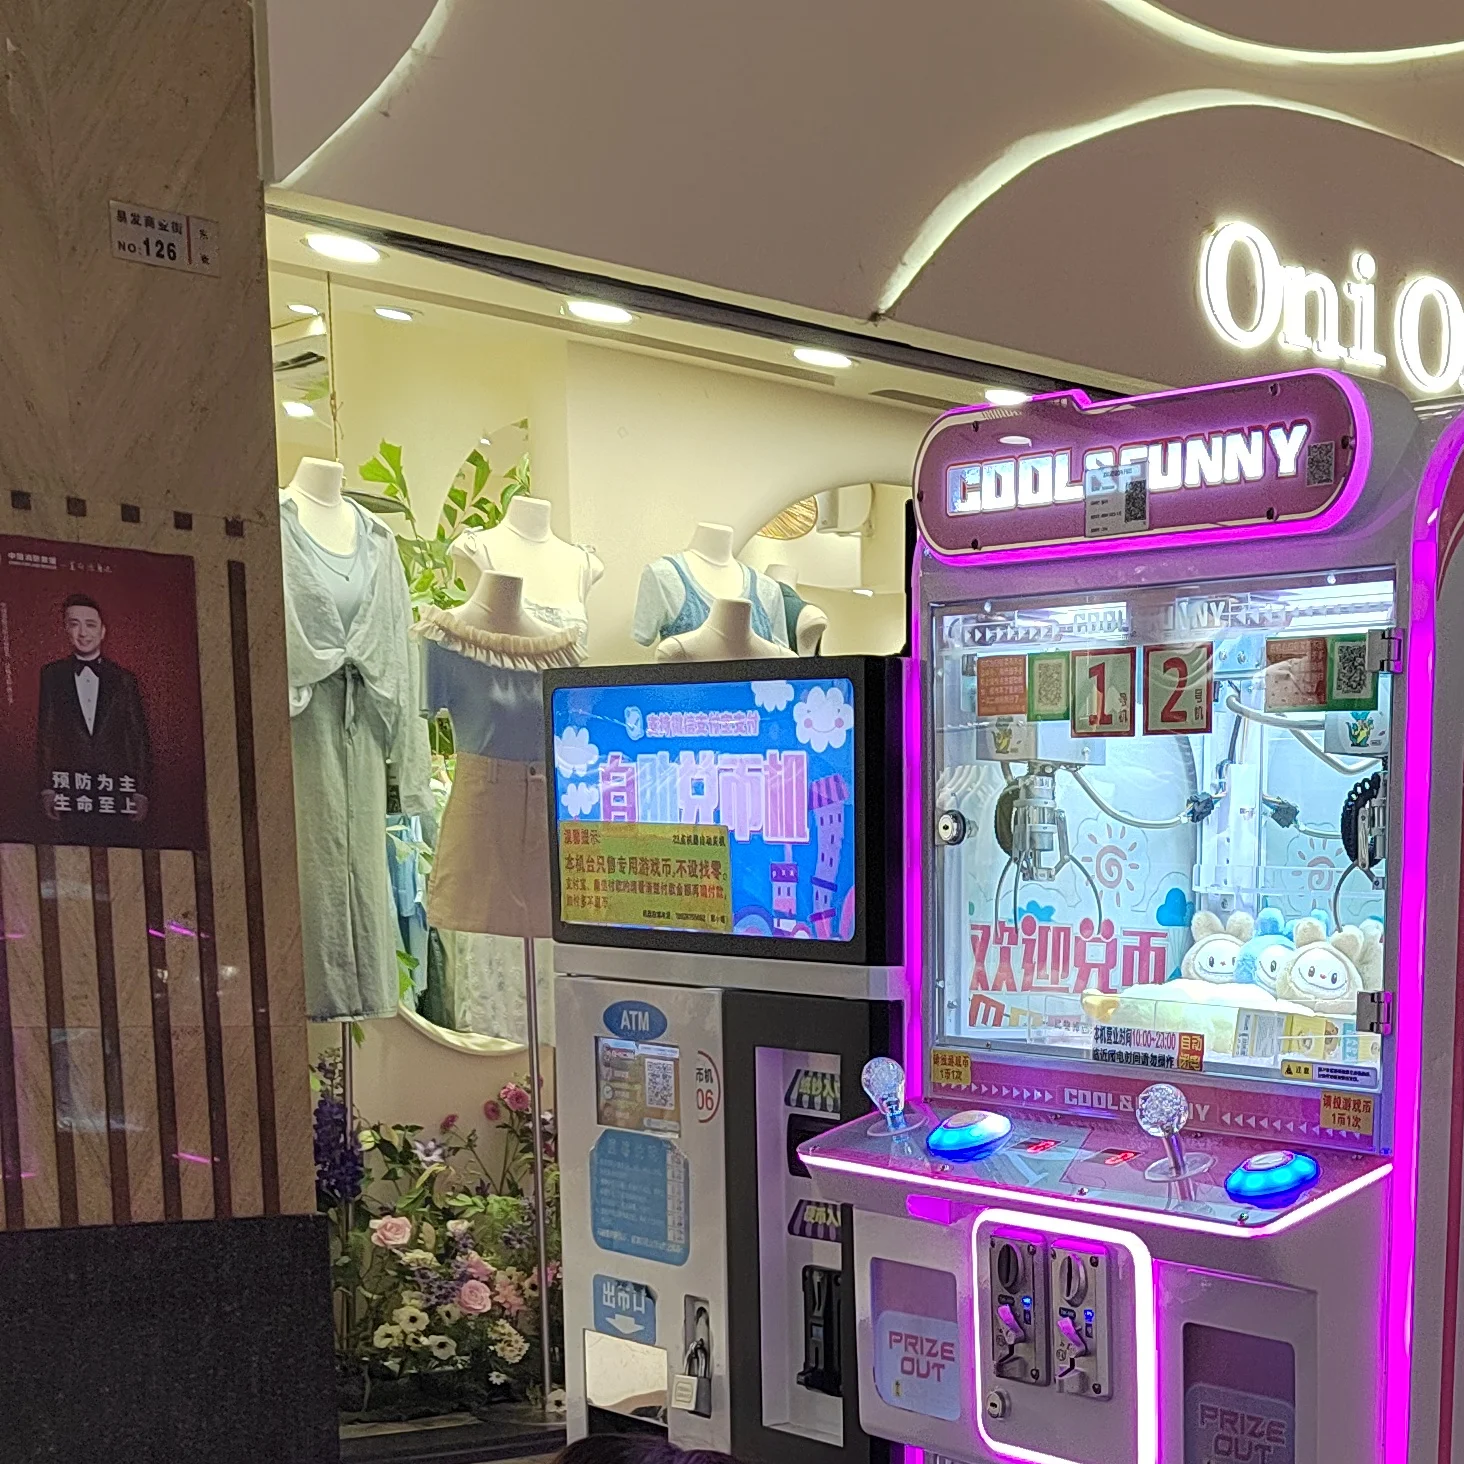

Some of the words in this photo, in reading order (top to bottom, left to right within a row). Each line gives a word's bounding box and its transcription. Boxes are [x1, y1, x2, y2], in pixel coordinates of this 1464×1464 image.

[1199, 220, 1386, 368] Oni
[1088, 661, 1113, 726] 1
[1160, 656, 1189, 723] 2
[52, 771, 137, 792] 预防为主
[53, 793, 139, 814] 生命至上
[969, 914, 1170, 993] 欢迎兑币
[620, 1009, 650, 1031] ATM
[696, 1088, 714, 1111] 06
[1331, 1113, 1361, 1129] 1币1次
[889, 1330, 955, 1363] PRIZE
[901, 1356, 945, 1383] OUT
[1199, 1403, 1287, 1446] PRIZE
